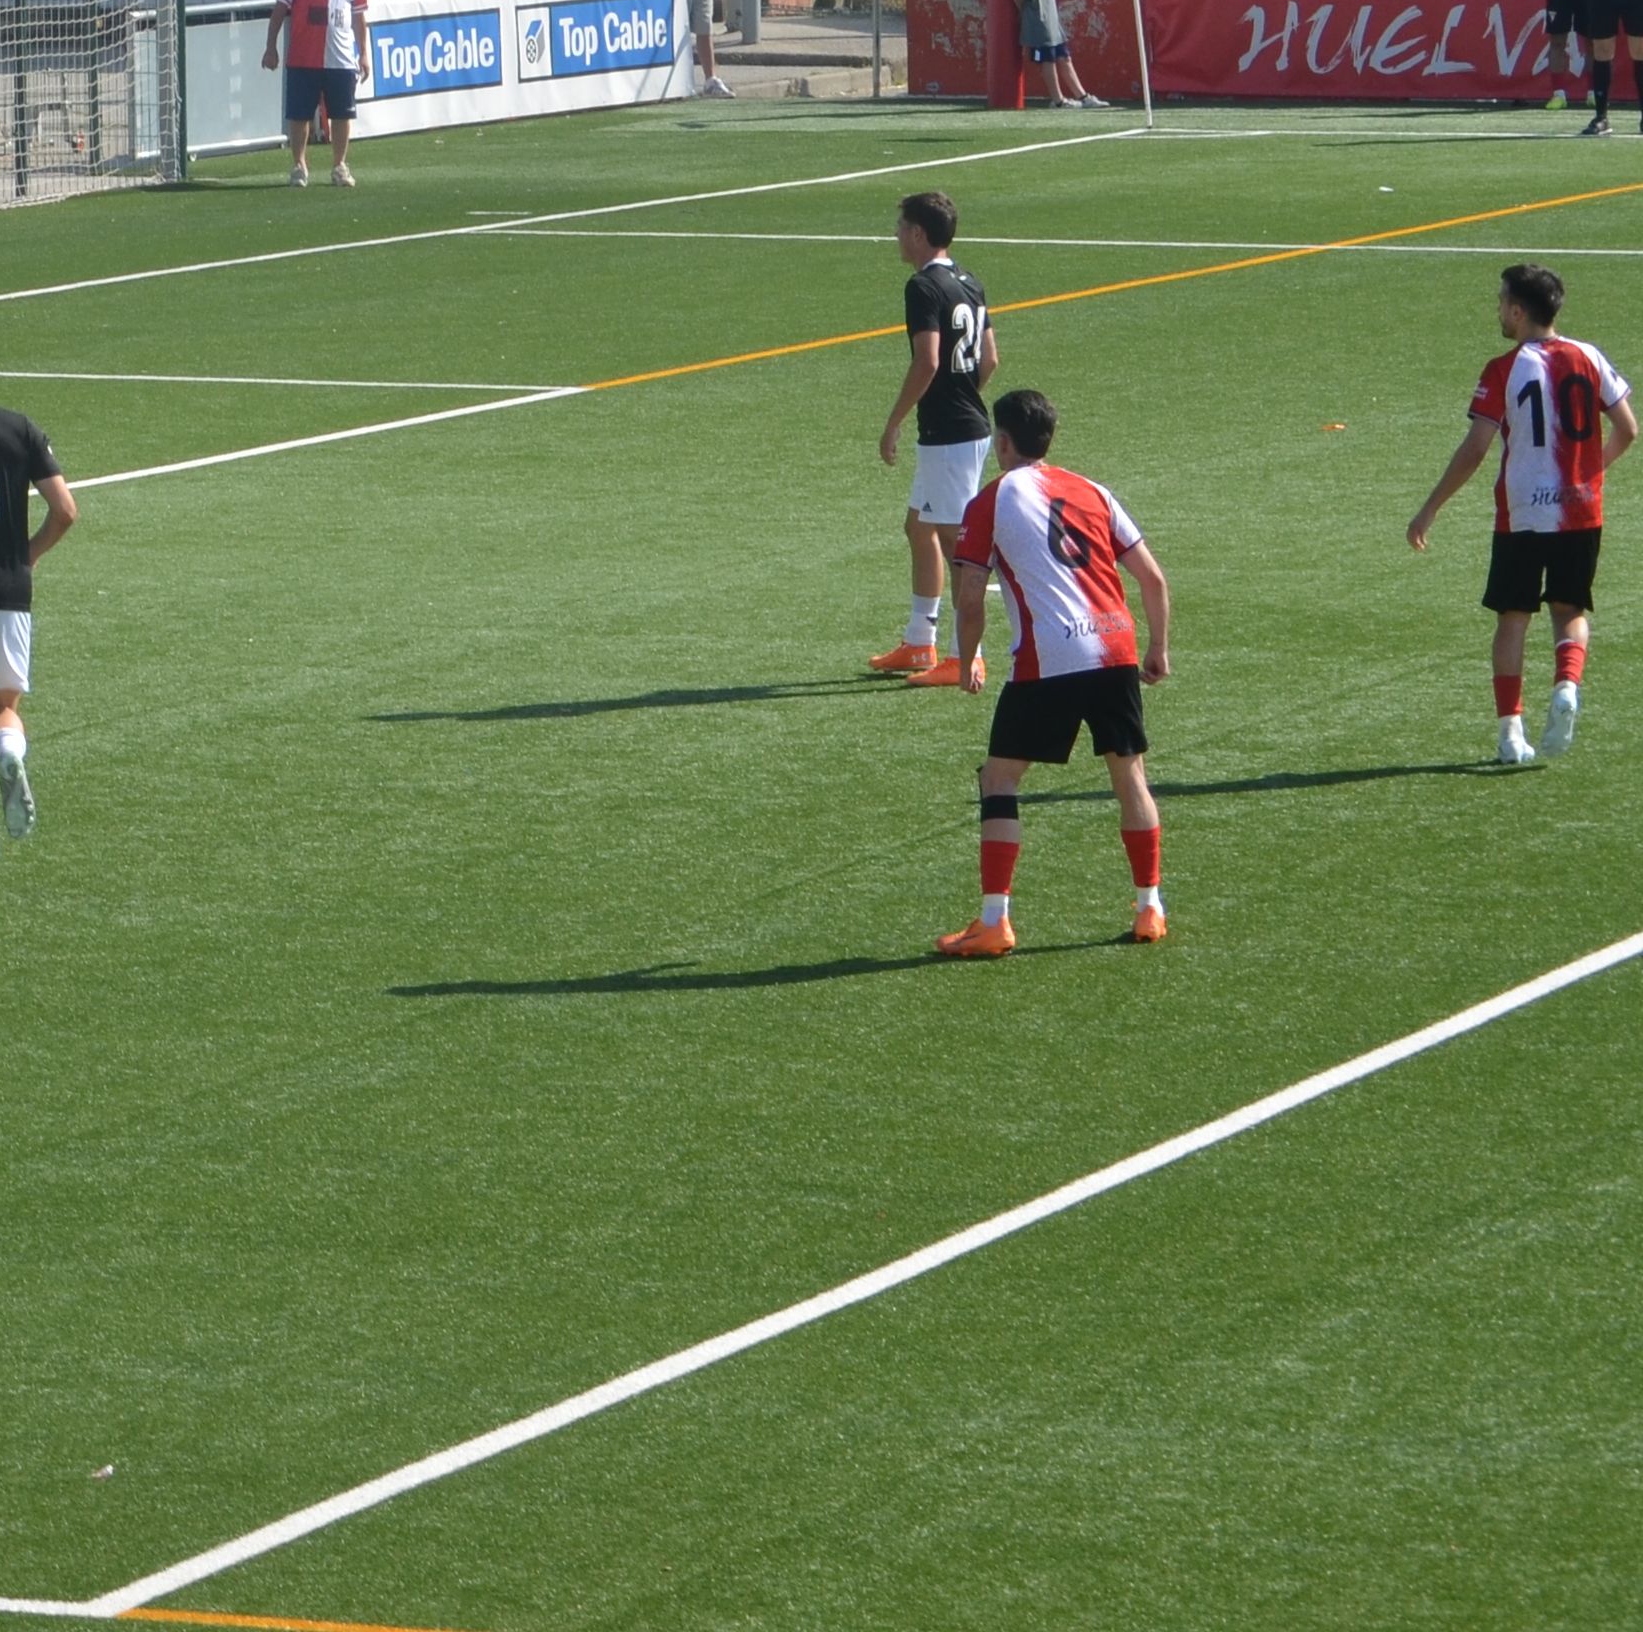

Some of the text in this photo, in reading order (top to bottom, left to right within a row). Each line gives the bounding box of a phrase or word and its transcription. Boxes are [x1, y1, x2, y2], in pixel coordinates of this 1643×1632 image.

[558, 9, 667, 66] Top Cable
[1516, 372, 1595, 448] 10
[1047, 496, 1093, 569] 6
